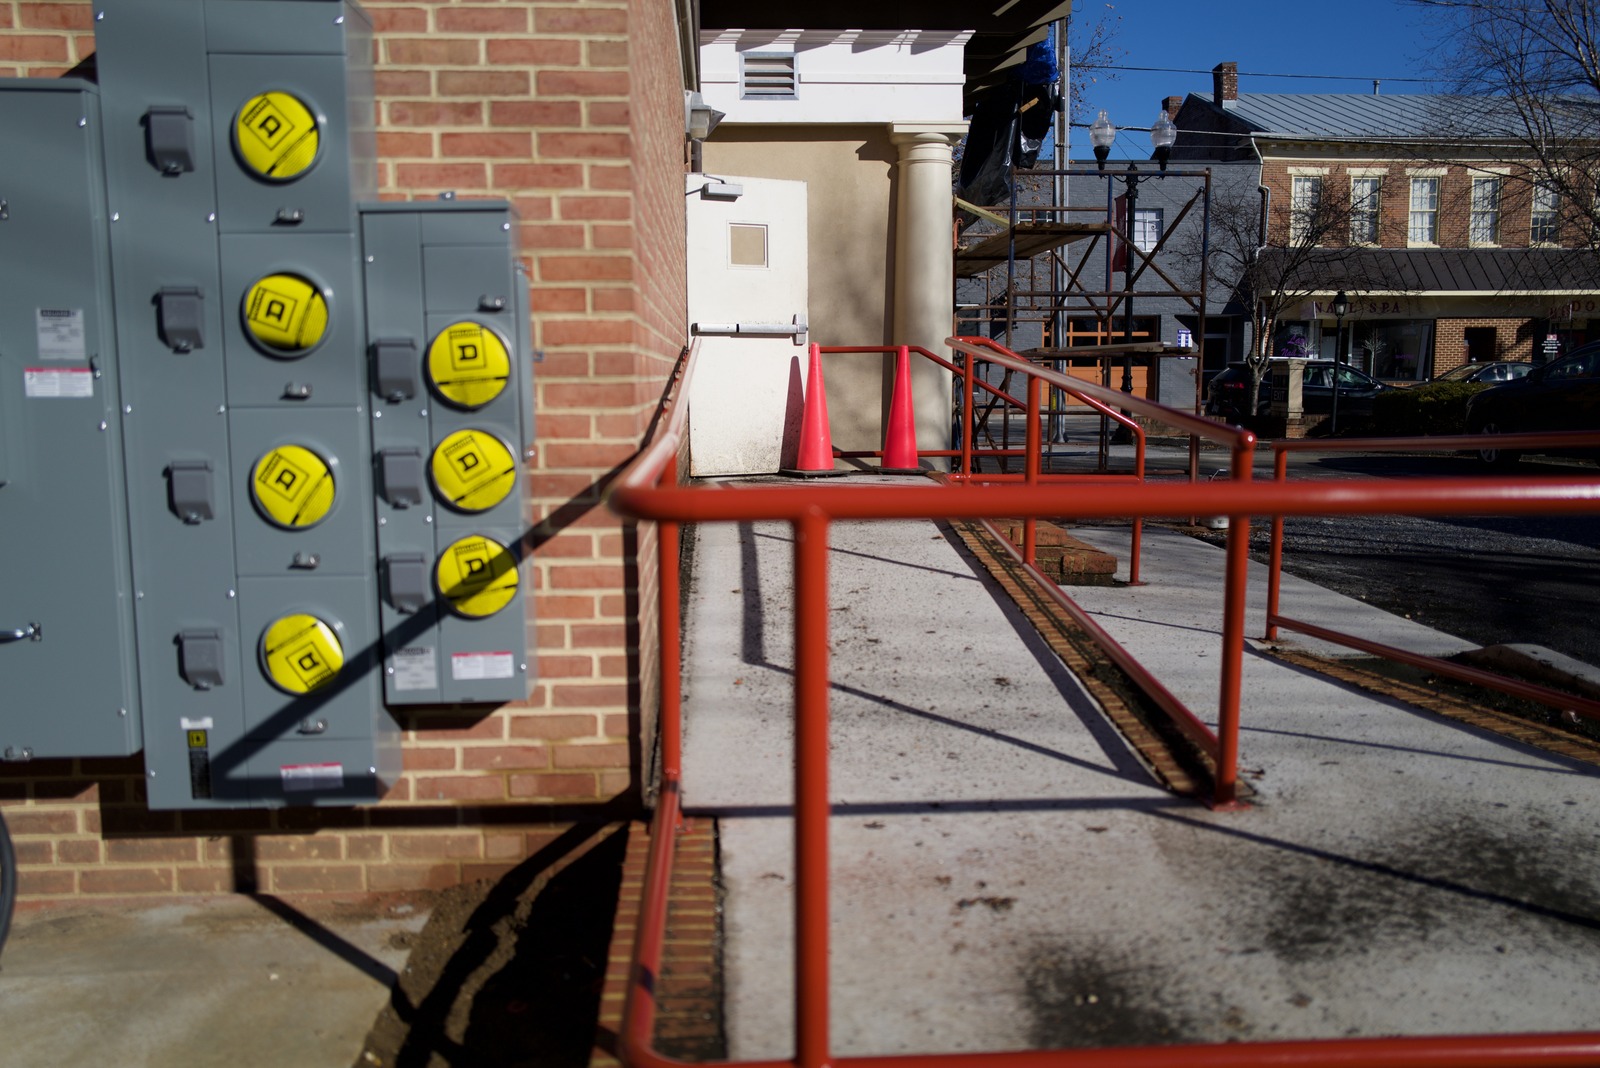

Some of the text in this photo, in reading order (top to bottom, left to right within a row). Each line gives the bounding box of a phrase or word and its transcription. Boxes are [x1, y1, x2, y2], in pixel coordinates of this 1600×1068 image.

[258, 115, 281, 138] D
[266, 299, 285, 321] D
[1315, 302, 1400, 313] NAL SPA
[458, 344, 478, 361] D
[457, 451, 480, 471] D
[275, 468, 297, 490] D
[465, 557, 486, 575] D
[297, 653, 319, 671] D
